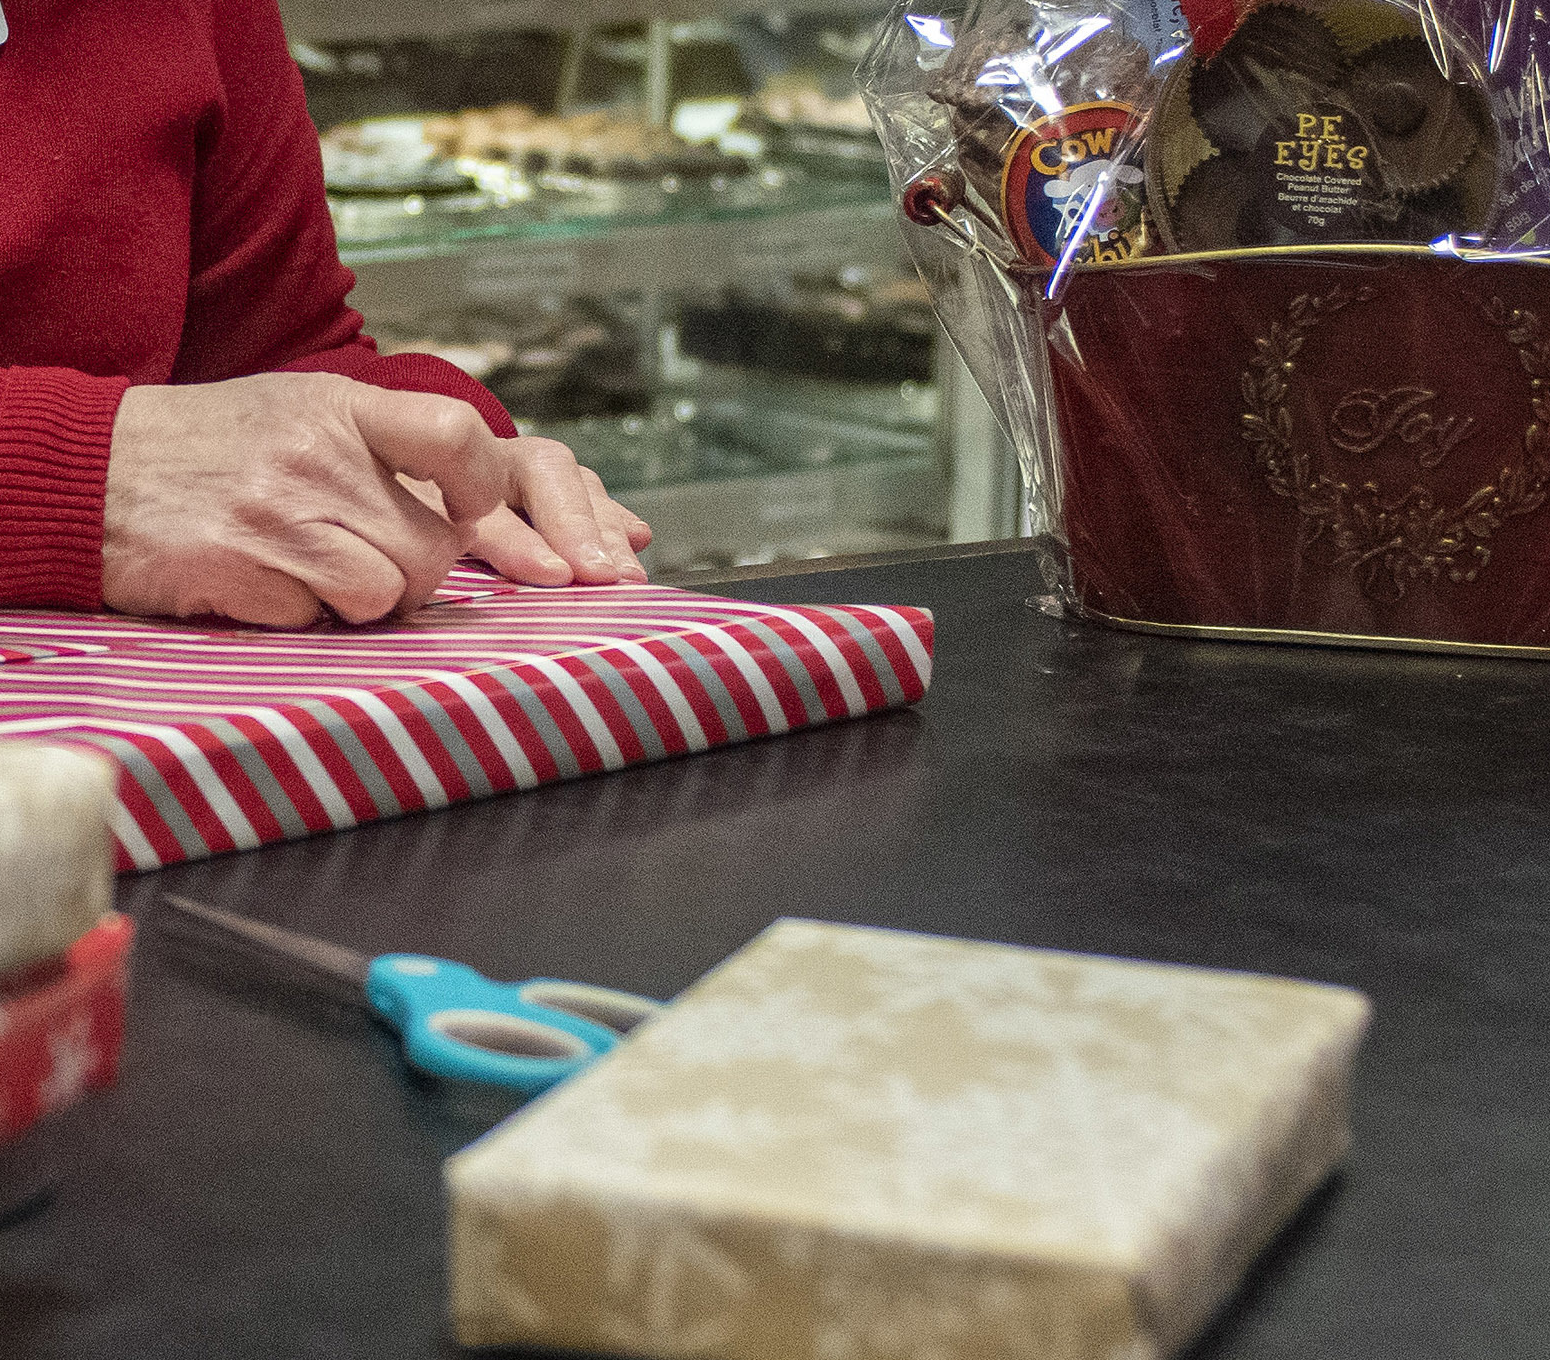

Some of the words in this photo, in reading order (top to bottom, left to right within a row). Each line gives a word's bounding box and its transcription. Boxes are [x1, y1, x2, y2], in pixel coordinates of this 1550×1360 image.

[1295, 113, 1346, 140] P.E.
[1030, 127, 1117, 176] Cow
[1274, 140, 1368, 171] EYES
[1276, 172, 1322, 184] Chocolate
[1324, 175, 1362, 186] Covered
[1287, 183, 1319, 192] Peanut
[1321, 184, 1350, 194] Butter
[1278, 192, 1309, 202] Beurre
[1292, 203, 1301, 212] et
[1303, 204, 1342, 214] chocolat
[1307, 215, 1326, 227] 70g
[1331, 387, 1474, 468] Joy
